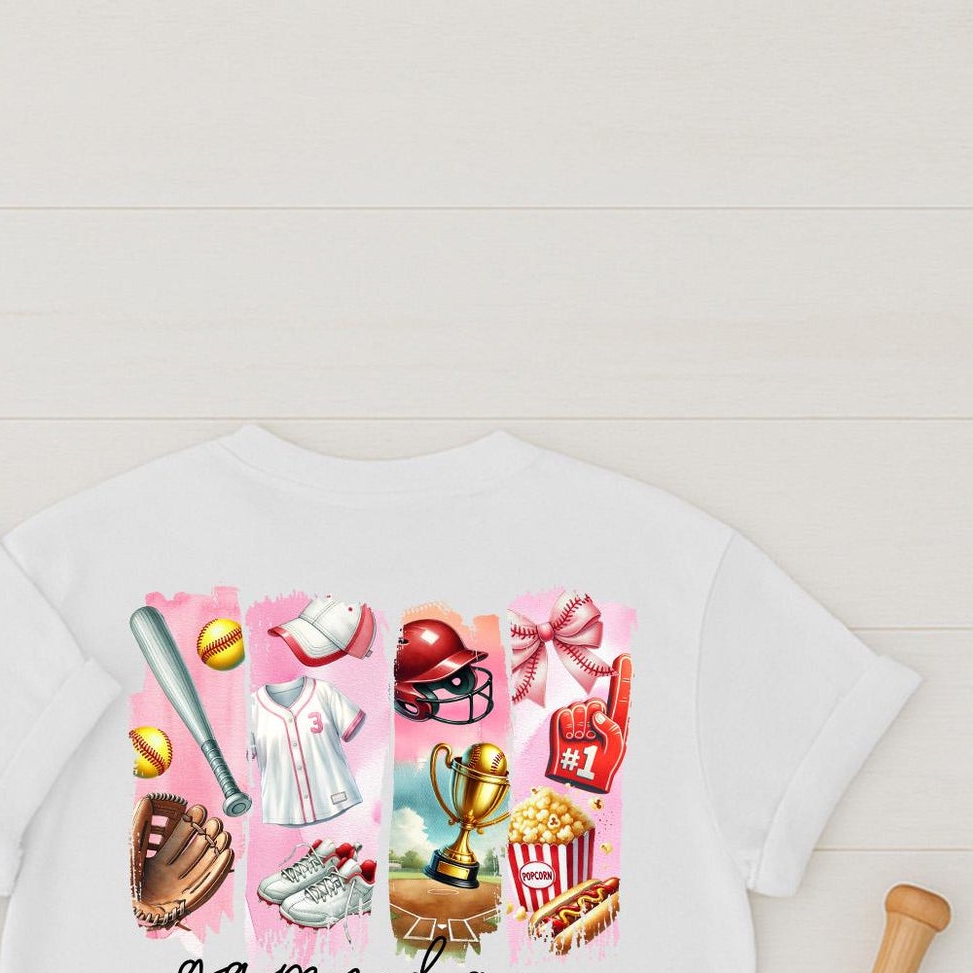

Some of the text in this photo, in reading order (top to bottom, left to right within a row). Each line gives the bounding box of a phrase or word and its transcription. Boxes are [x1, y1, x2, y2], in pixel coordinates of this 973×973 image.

[308, 711, 324, 734] 3
[560, 745, 598, 780] #1
[522, 871, 553, 881] POPCORN
